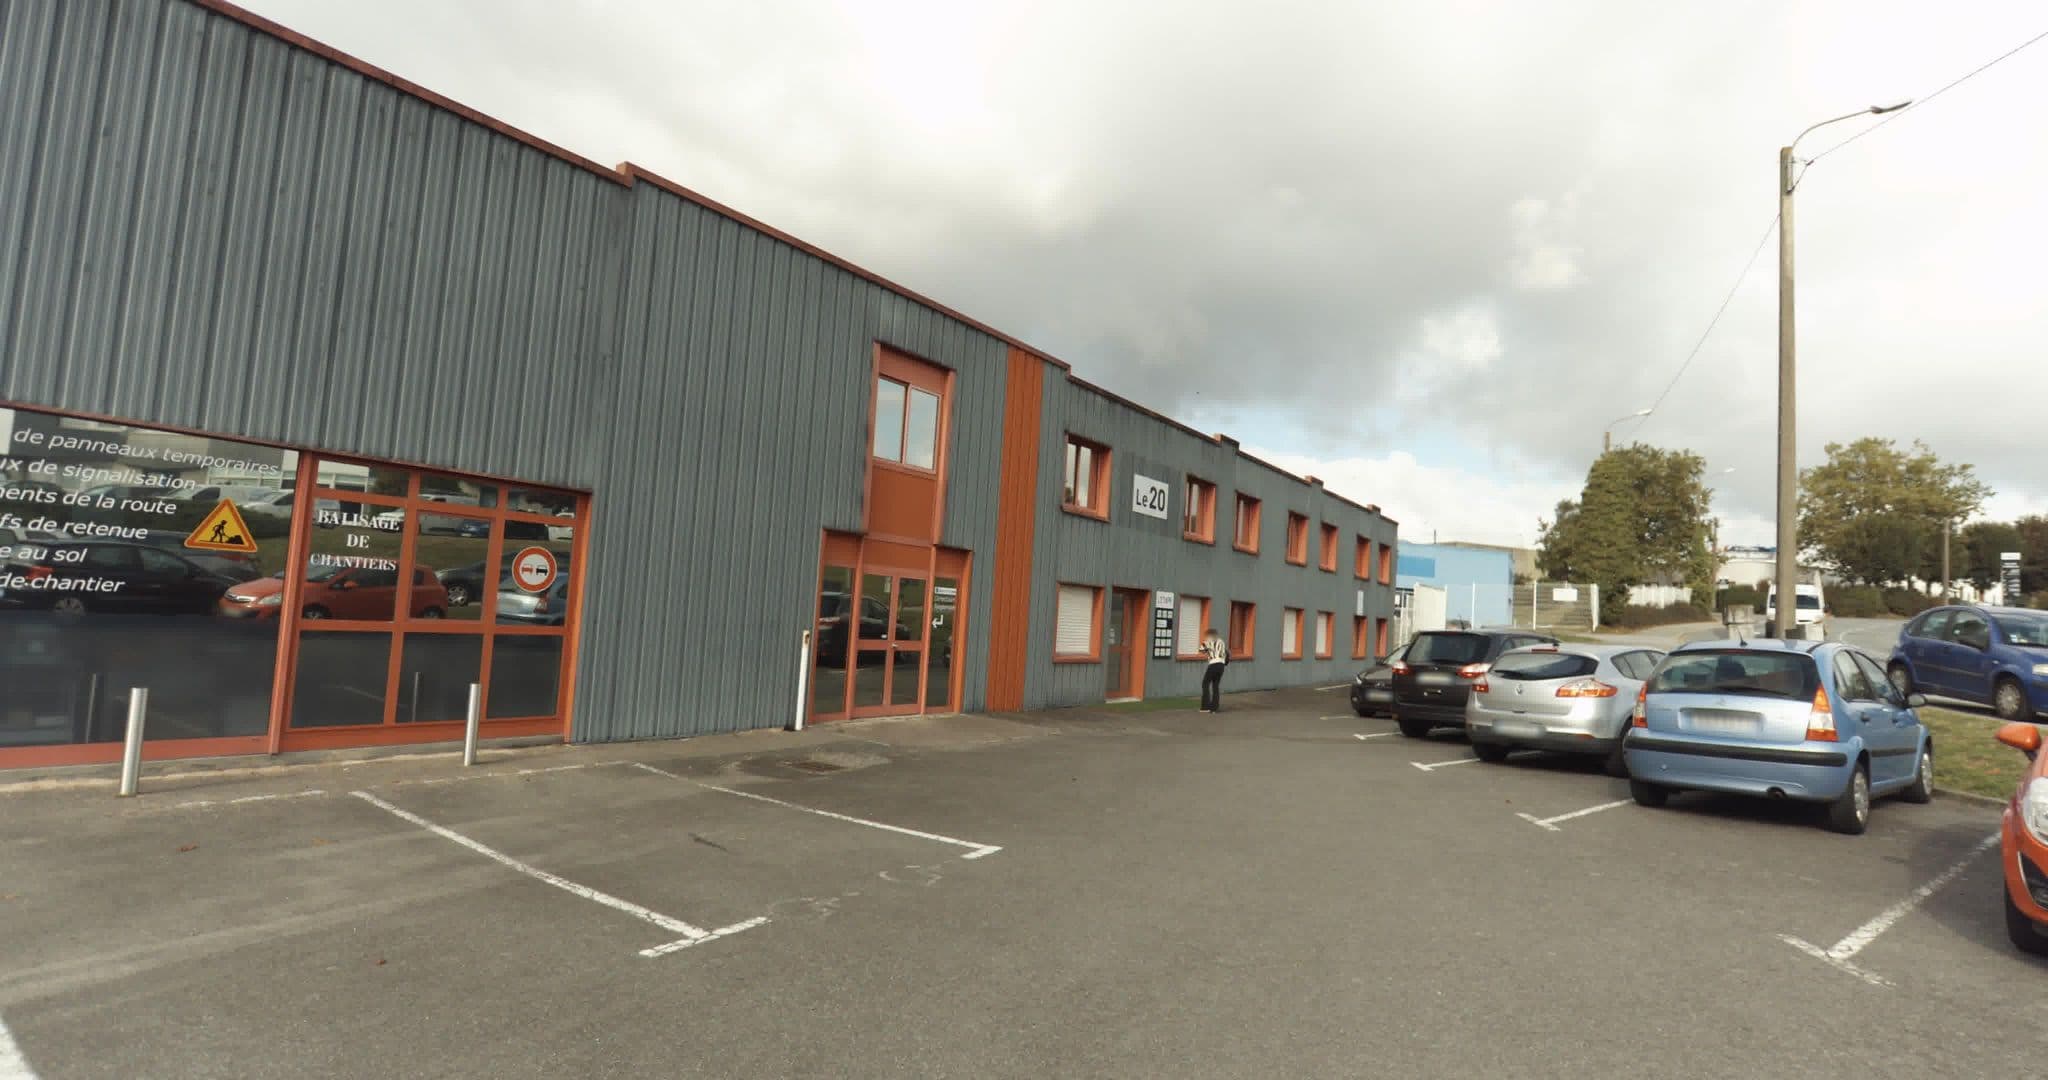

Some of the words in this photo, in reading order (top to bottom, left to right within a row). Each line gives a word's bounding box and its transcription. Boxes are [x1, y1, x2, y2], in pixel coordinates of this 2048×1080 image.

[14, 428, 44, 444] de
[48, 434, 158, 459] panneaux
[163, 447, 279, 476] temporaires
[28, 459, 58, 475] de
[62, 463, 196, 490] signalisation
[62, 491, 91, 507] de
[96, 494, 115, 509] la
[120, 498, 177, 514] route
[1136, 488, 1148, 507] Le
[1149, 486, 1166, 511] 20
[28, 516, 57, 532] de
[62, 521, 148, 539] retenue
[318, 509, 400, 531] BALISAGE
[346, 533, 370, 549] DE
[18, 547, 48, 560] au
[53, 547, 88, 563] sol
[310, 553, 397, 571] CHANTIERS
[31, 573, 126, 592] chantier
